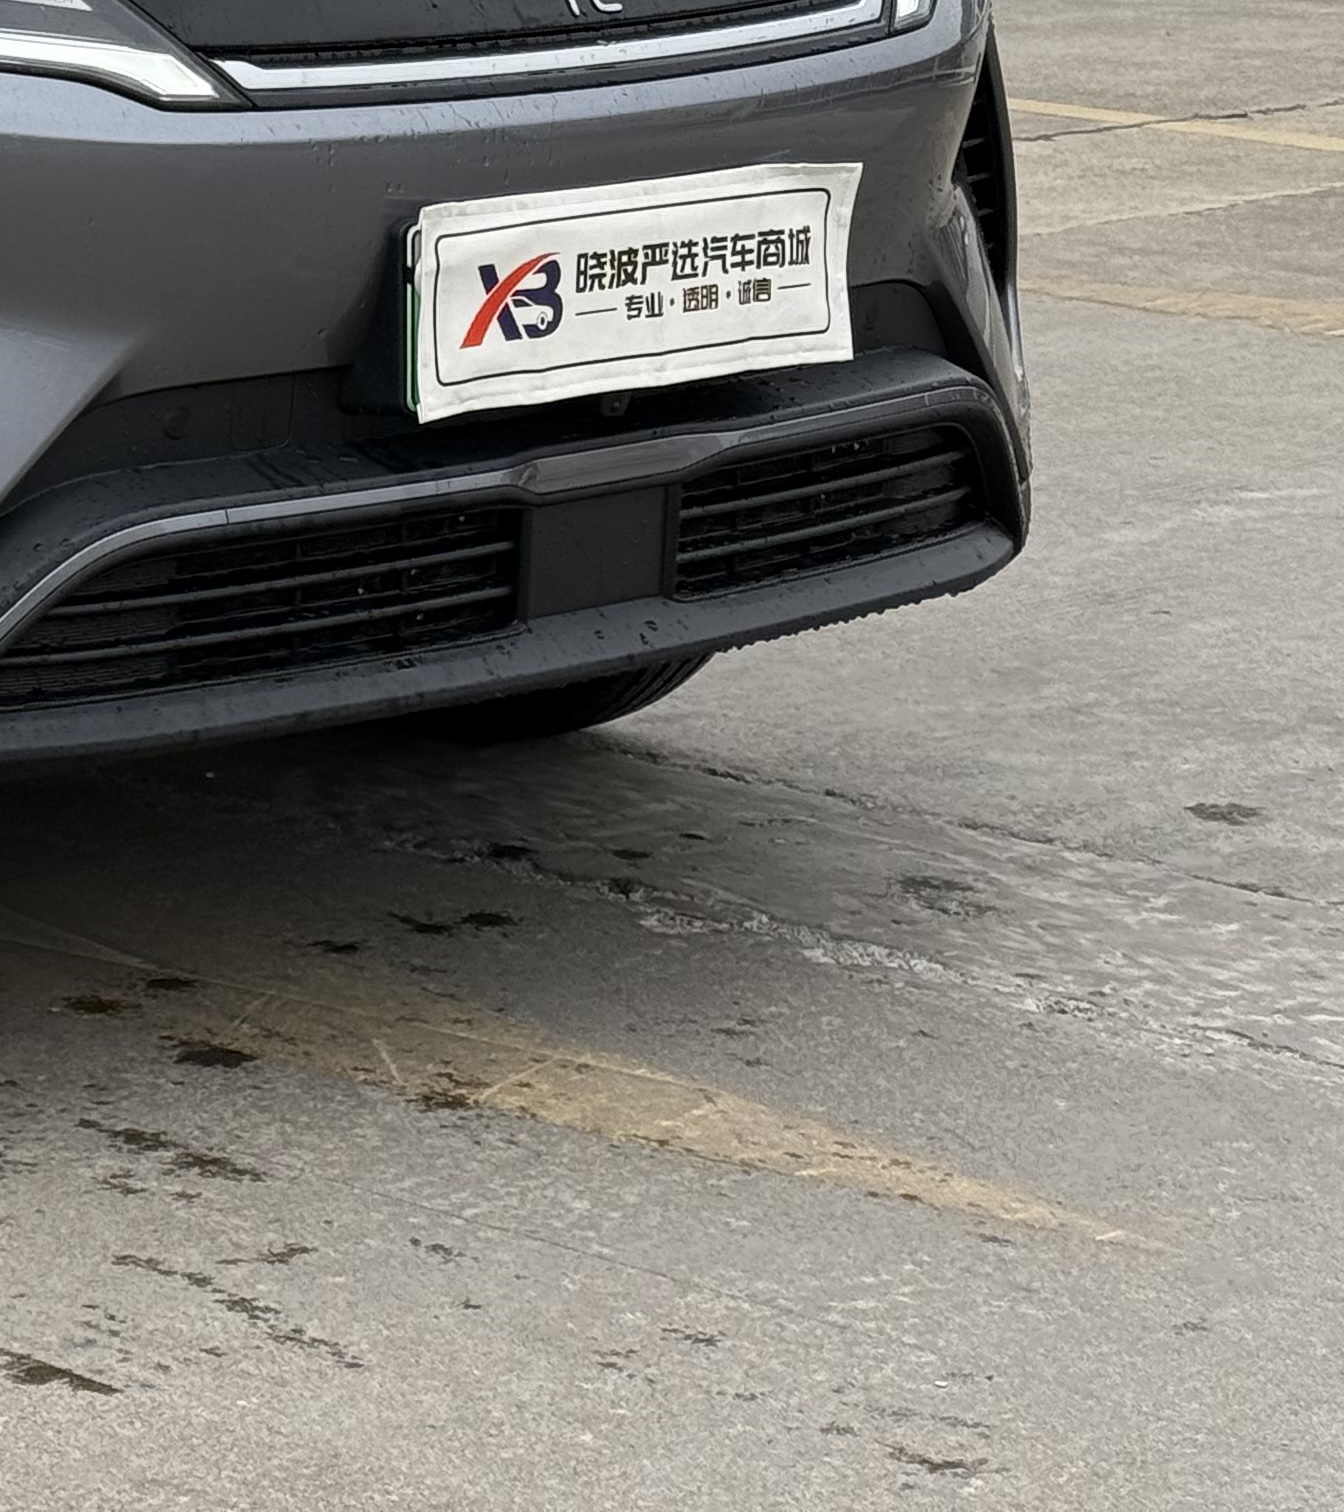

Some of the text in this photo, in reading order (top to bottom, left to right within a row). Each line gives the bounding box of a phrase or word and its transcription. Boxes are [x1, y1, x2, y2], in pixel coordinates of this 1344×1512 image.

[575, 225, 812, 294] 晓波严选汽车商城
